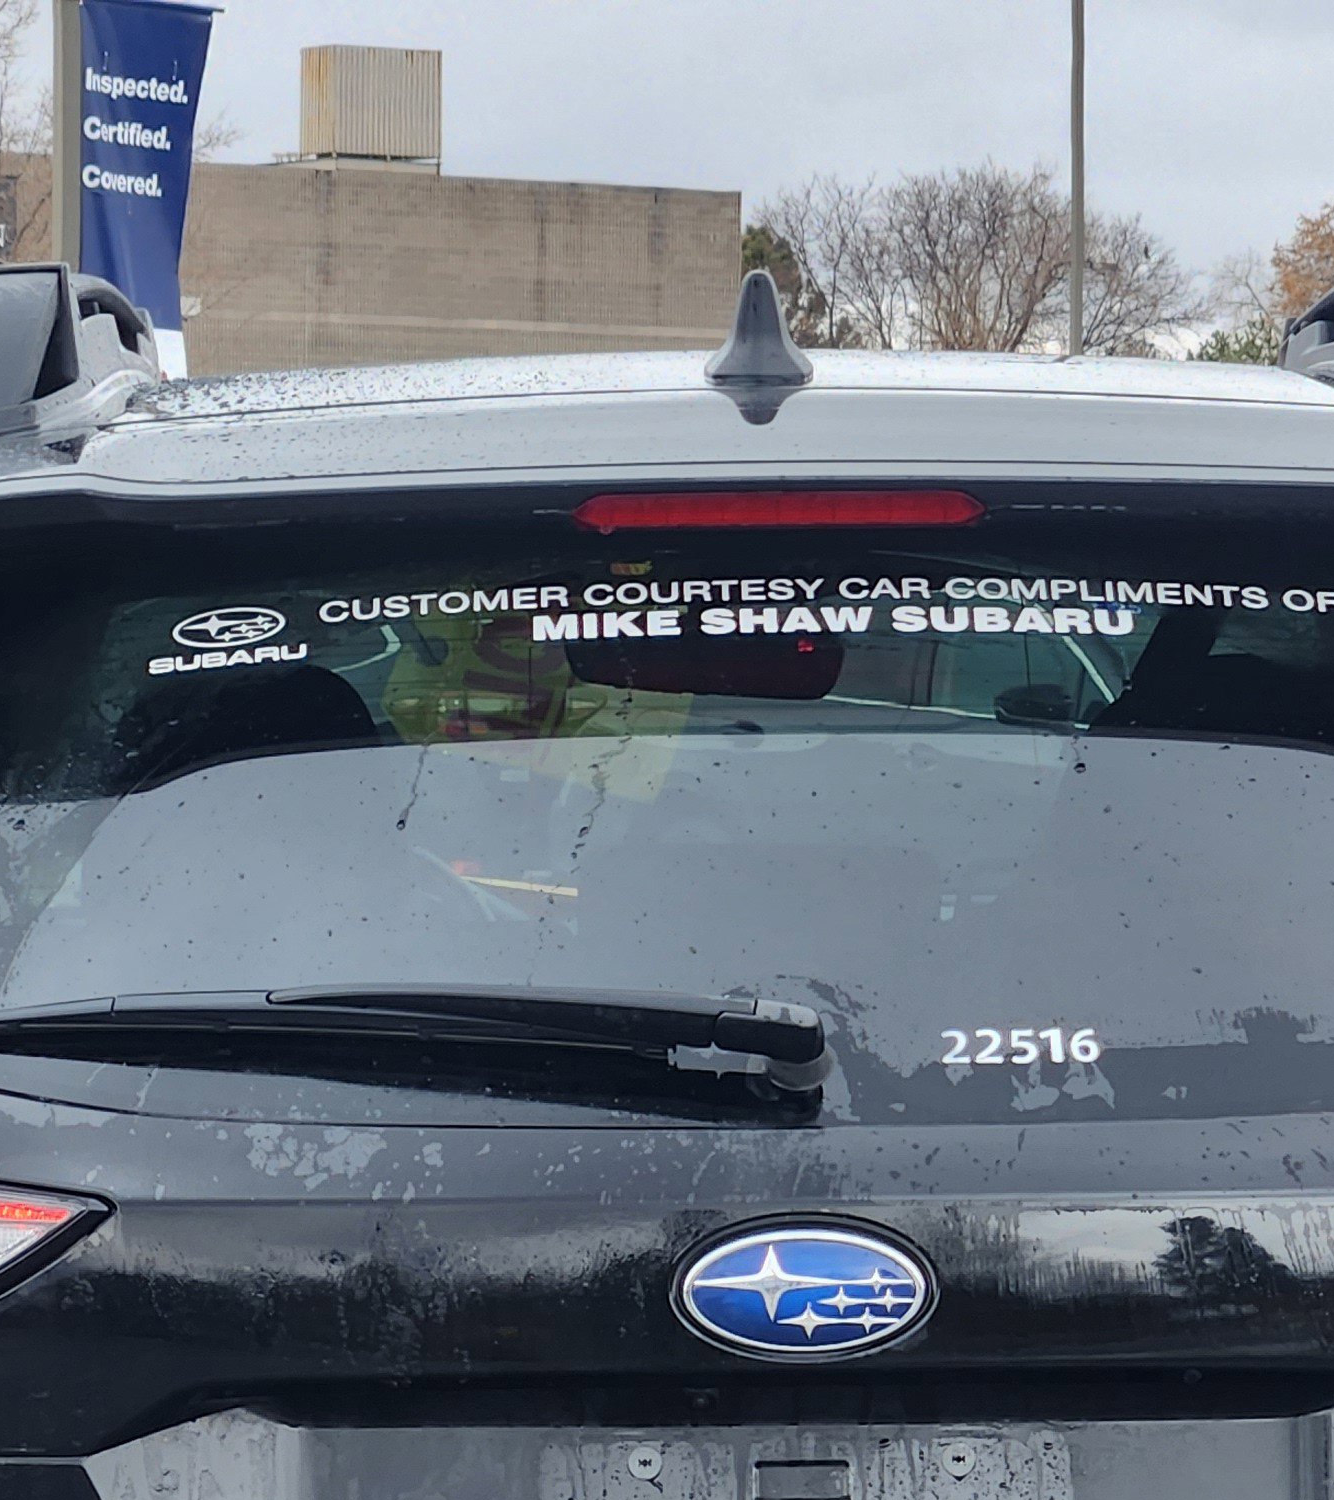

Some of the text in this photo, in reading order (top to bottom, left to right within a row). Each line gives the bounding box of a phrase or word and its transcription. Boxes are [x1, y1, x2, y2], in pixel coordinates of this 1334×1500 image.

[85, 66, 189, 105] Inspected.
[83, 115, 171, 151] Certified.
[82, 164, 163, 198] Covered.
[319, 586, 569, 623] CUSTOMER
[583, 578, 824, 606] COURTESY
[838, 577, 932, 600] CAR
[940, 577, 1269, 609] COMPLIMENTS
[532, 605, 1135, 641] MIKE SHAW SUBARU
[148, 643, 308, 675] SUBARU
[940, 1028, 1101, 1065] 22516
